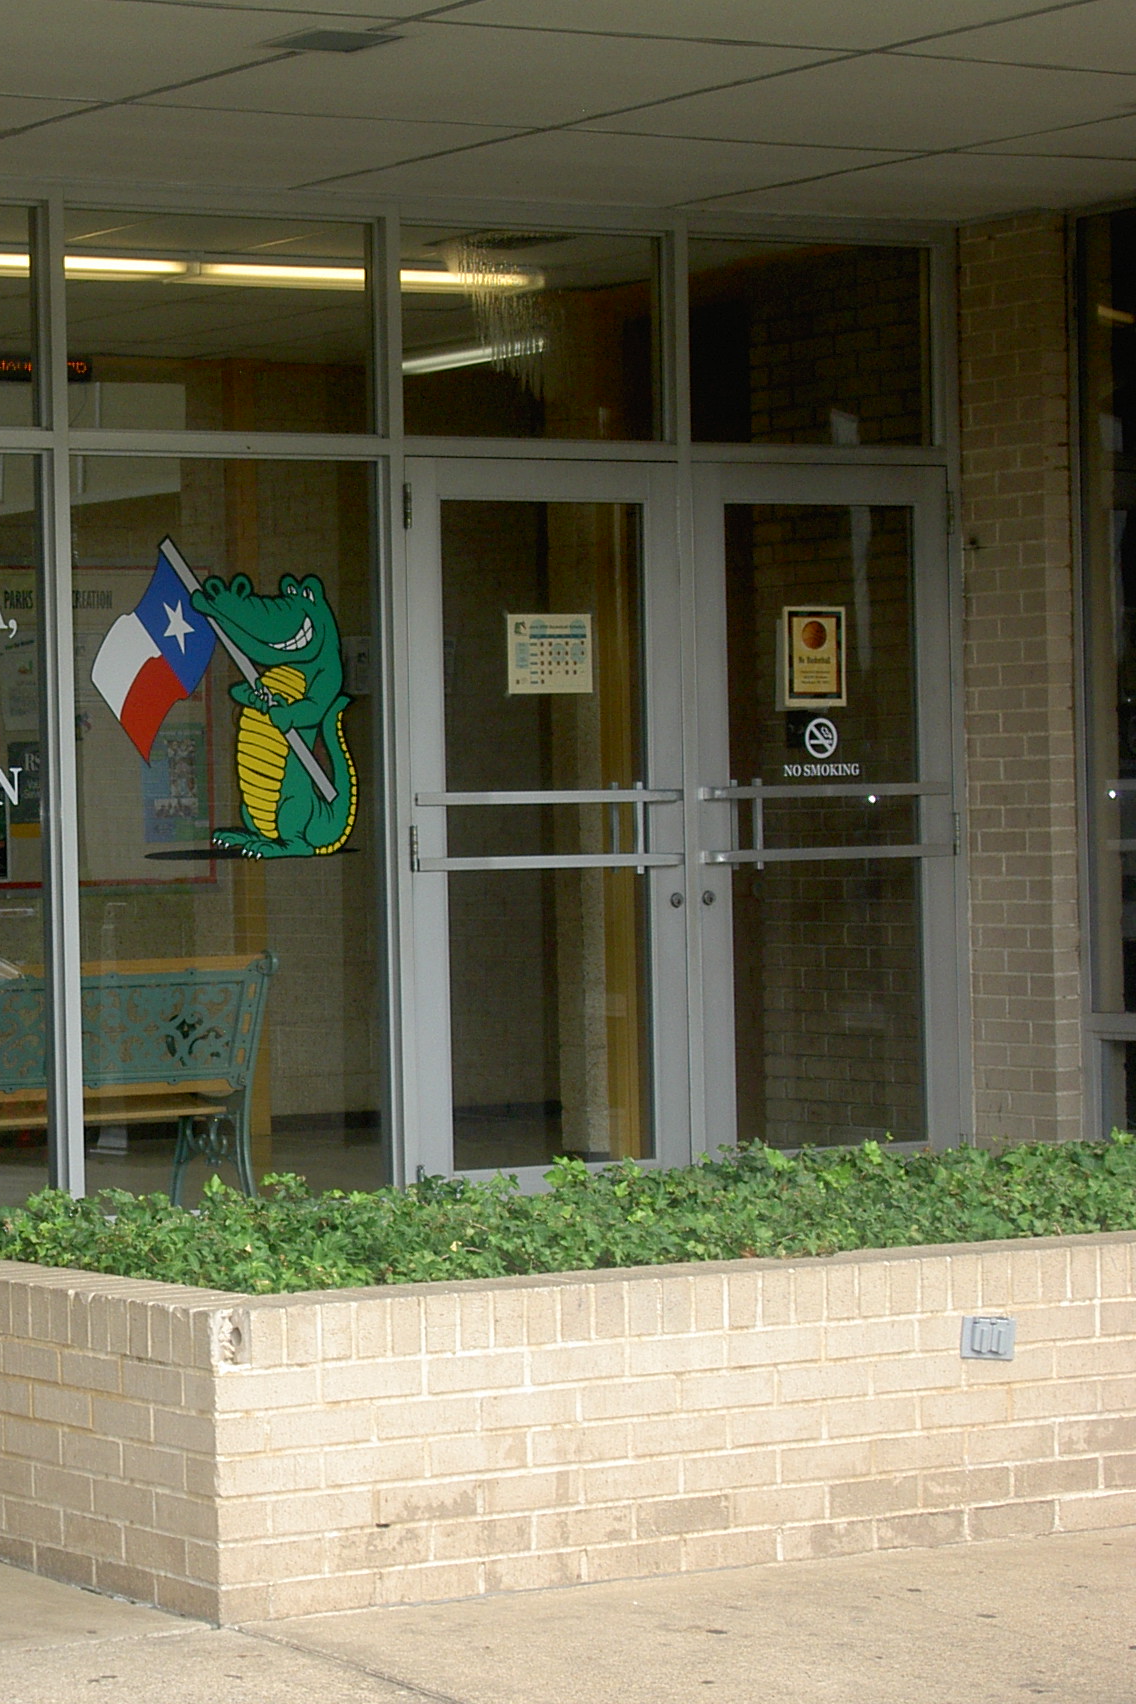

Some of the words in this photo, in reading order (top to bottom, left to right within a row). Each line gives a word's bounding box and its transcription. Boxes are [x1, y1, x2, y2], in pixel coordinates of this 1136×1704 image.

[4, 590, 33, 609] PARKS
[784, 765, 801, 776] NO
[804, 764, 859, 776] SMOKING
